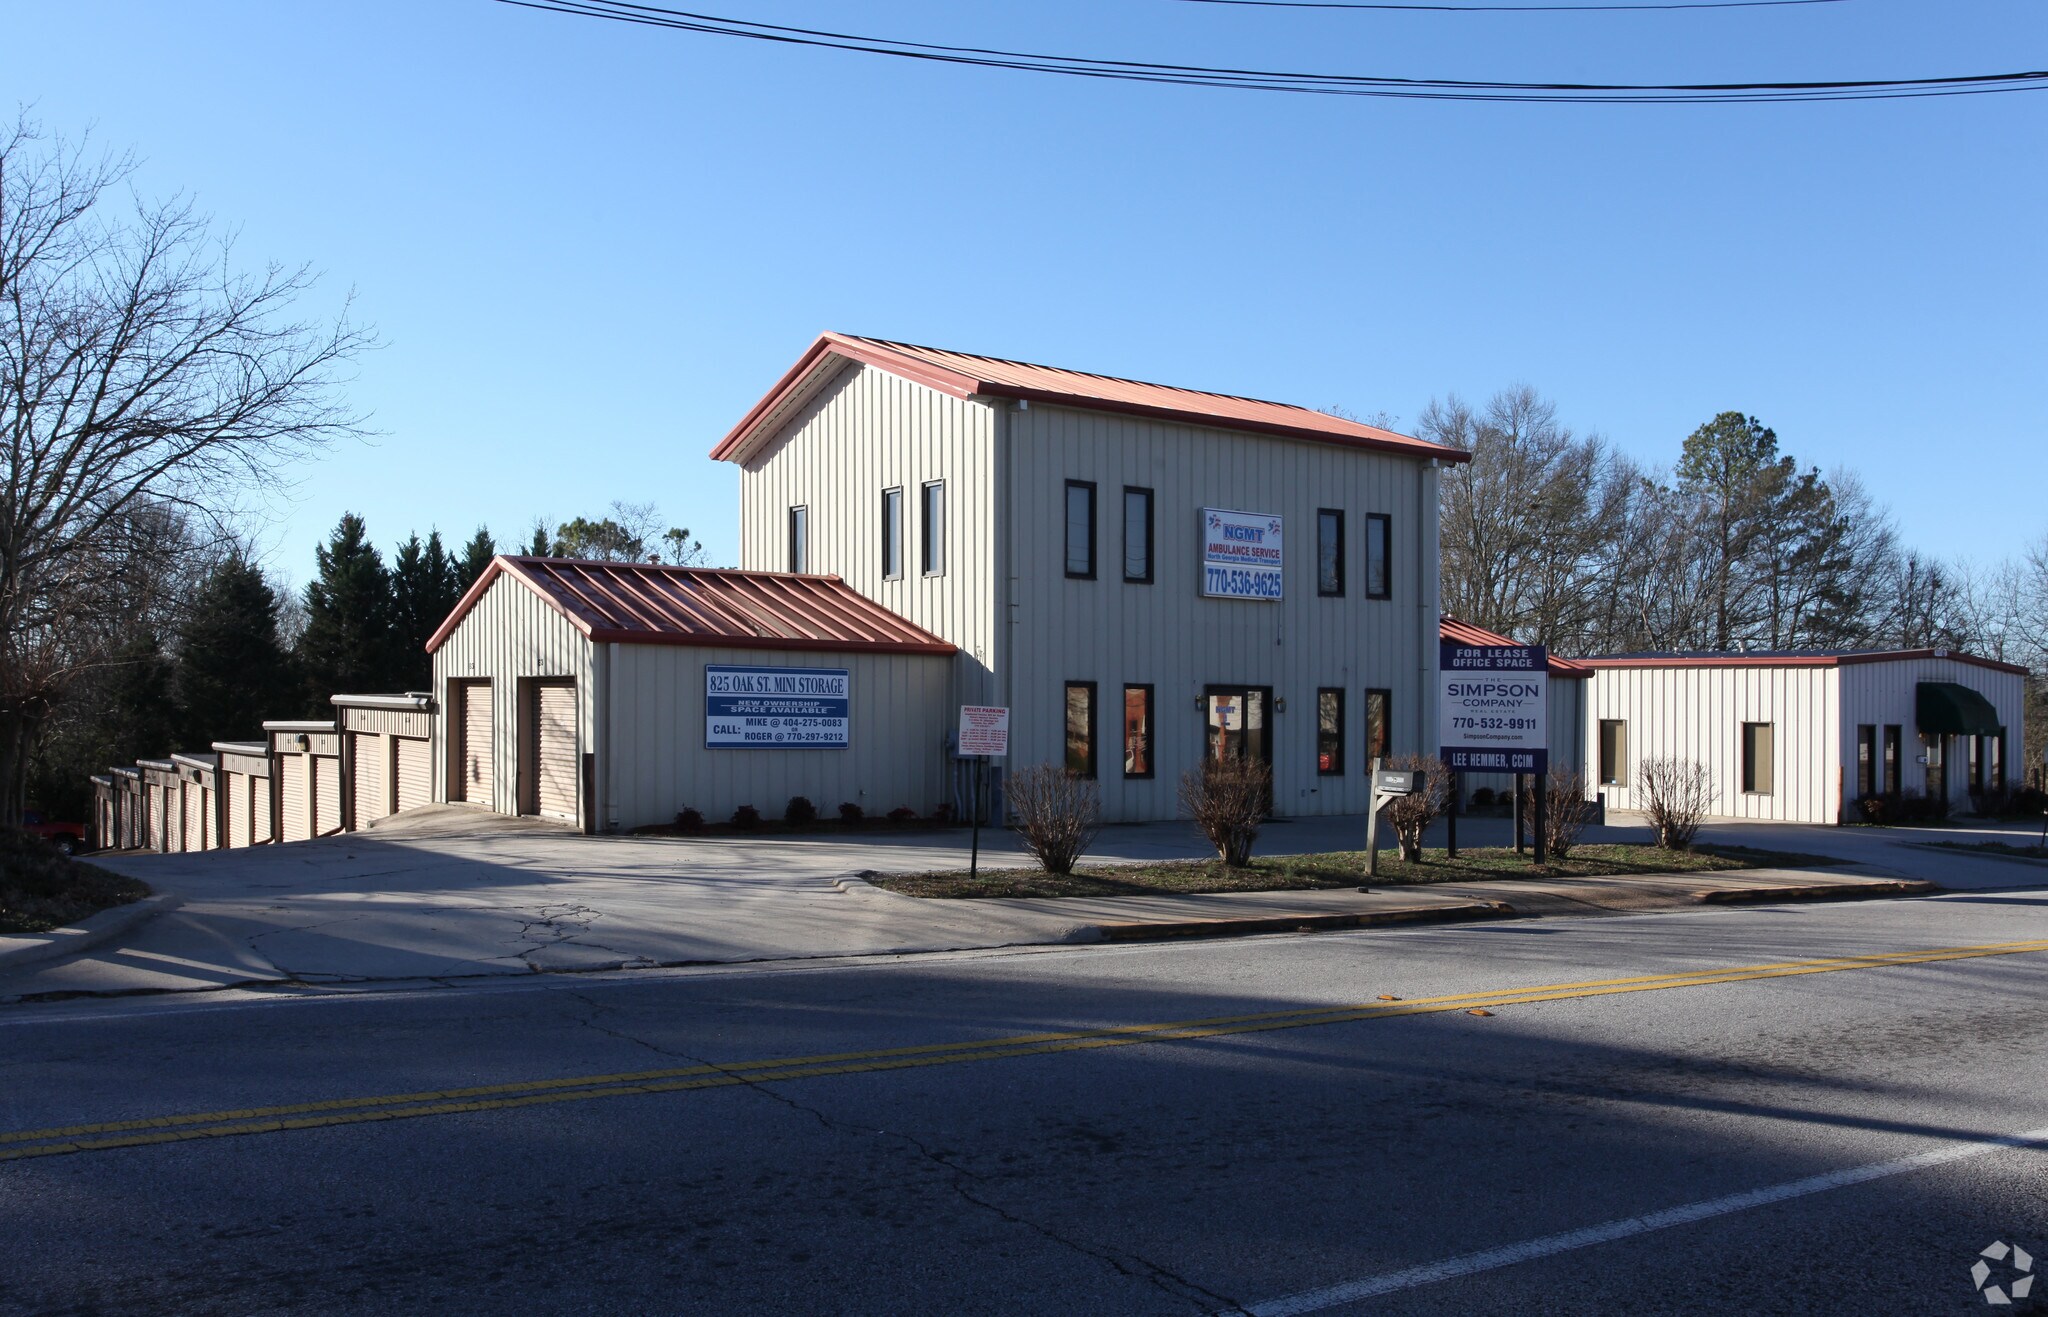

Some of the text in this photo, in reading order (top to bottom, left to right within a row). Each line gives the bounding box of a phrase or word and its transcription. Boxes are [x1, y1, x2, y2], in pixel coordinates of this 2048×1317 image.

[1224, 524, 1265, 543] NGMT
[1208, 543, 1280, 558] AMBULANCE SERVICE
[1208, 568, 1280, 596] 770-536-9625
[1456, 649, 1528, 657] FOR LEASE
[1453, 659, 1533, 667] OFFICE SPACE
[710, 676, 844, 693] 825 OAK ST. MINI STORAGE
[1448, 684, 1539, 697] SIMPSON
[1463, 699, 1523, 707] COMPANY
[746, 718, 842, 728] MIKE @ 404-275-0083
[1453, 718, 1536, 729] 770-532-9911
[713, 725, 741, 734] CALL:
[774, 733, 784, 741] @
[1453, 753, 1533, 768] LEE HEMMER, CCIM
